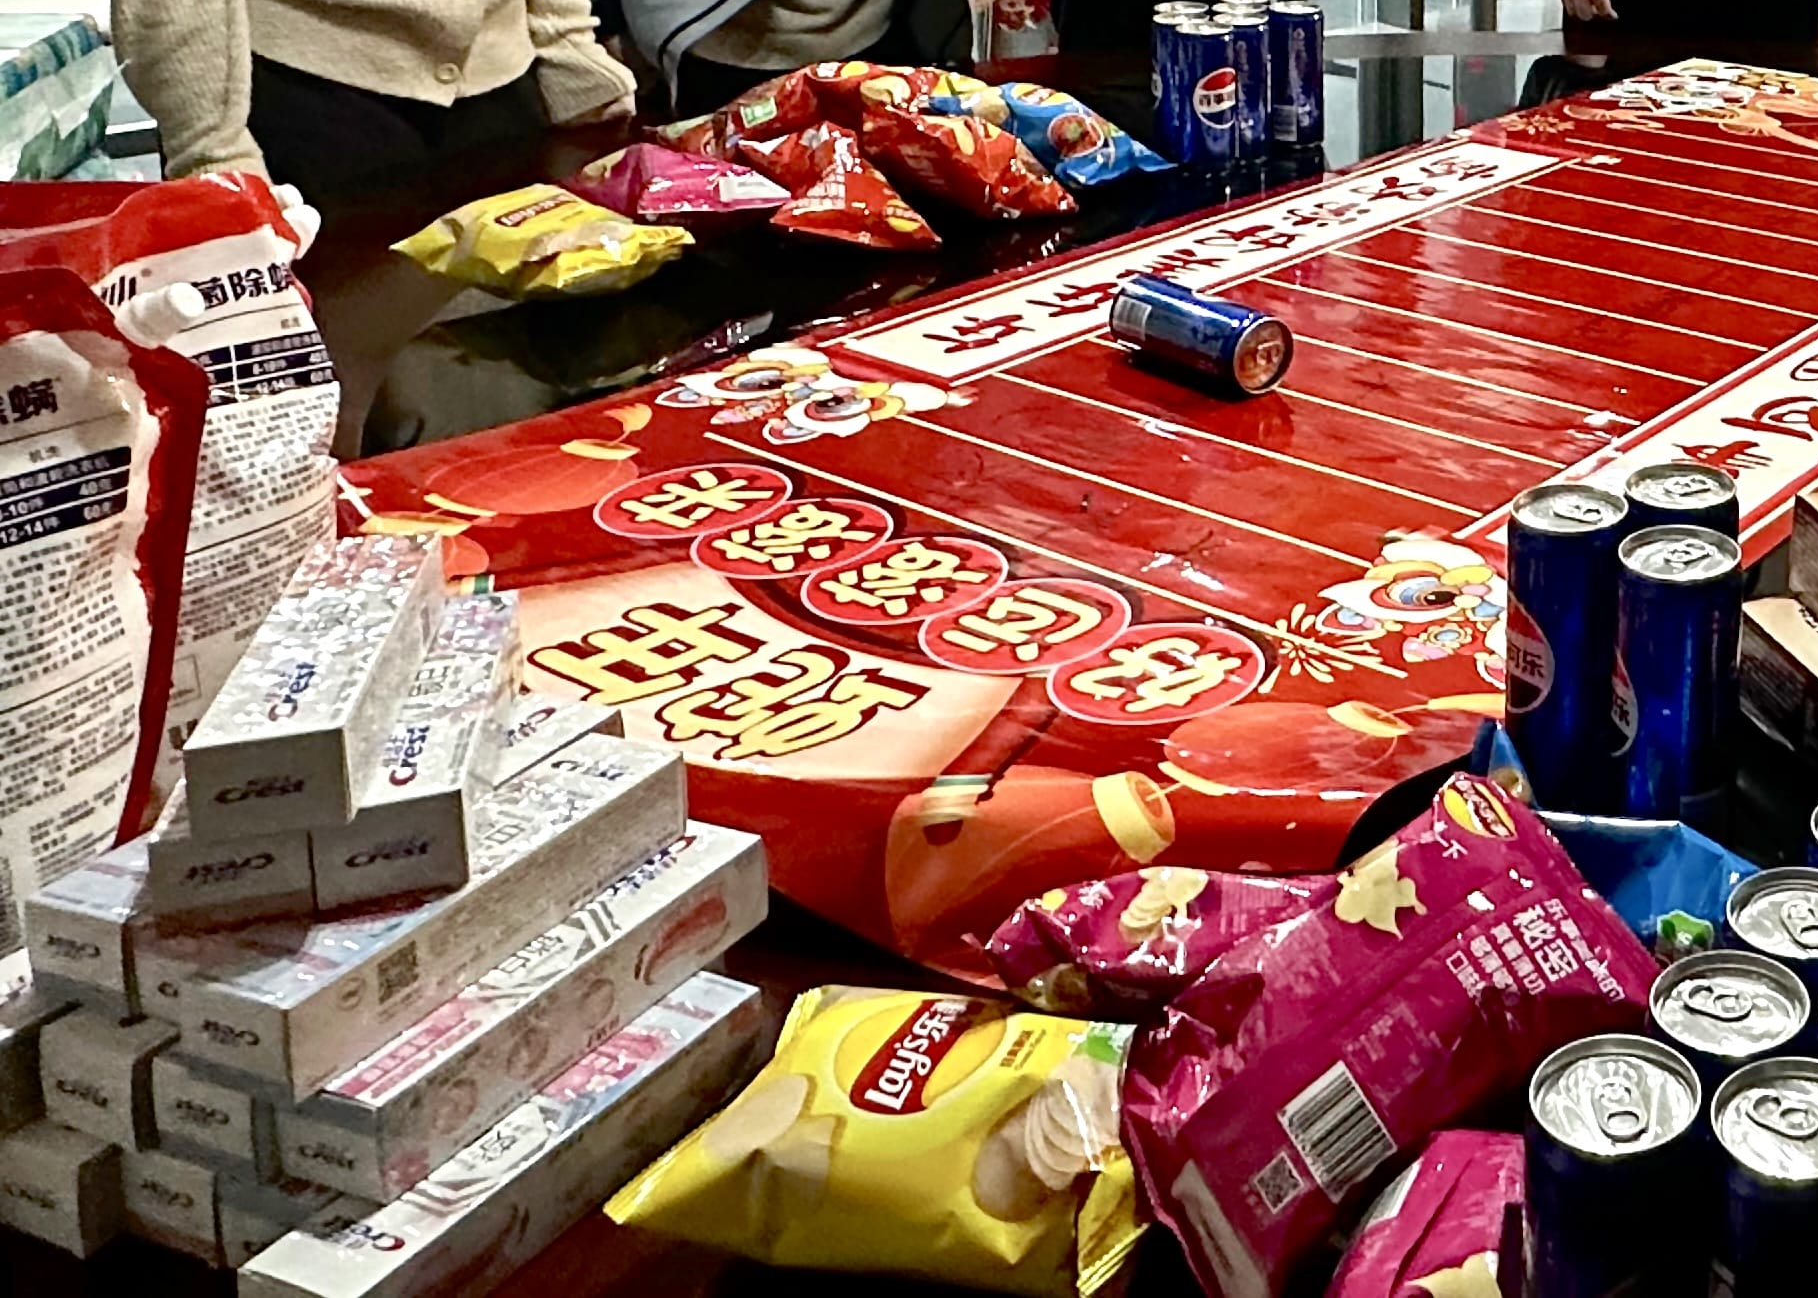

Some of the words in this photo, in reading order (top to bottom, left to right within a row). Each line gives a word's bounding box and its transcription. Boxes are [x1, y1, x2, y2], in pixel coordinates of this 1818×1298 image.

[620, 470, 1244, 715] 好运滚滚来
[268, 661, 317, 722] Crest
[528, 602, 932, 761] 蛇年
[389, 724, 431, 787] Crest
[1512, 903, 1579, 983] 秘密
[863, 1034, 932, 1111] Lay's
